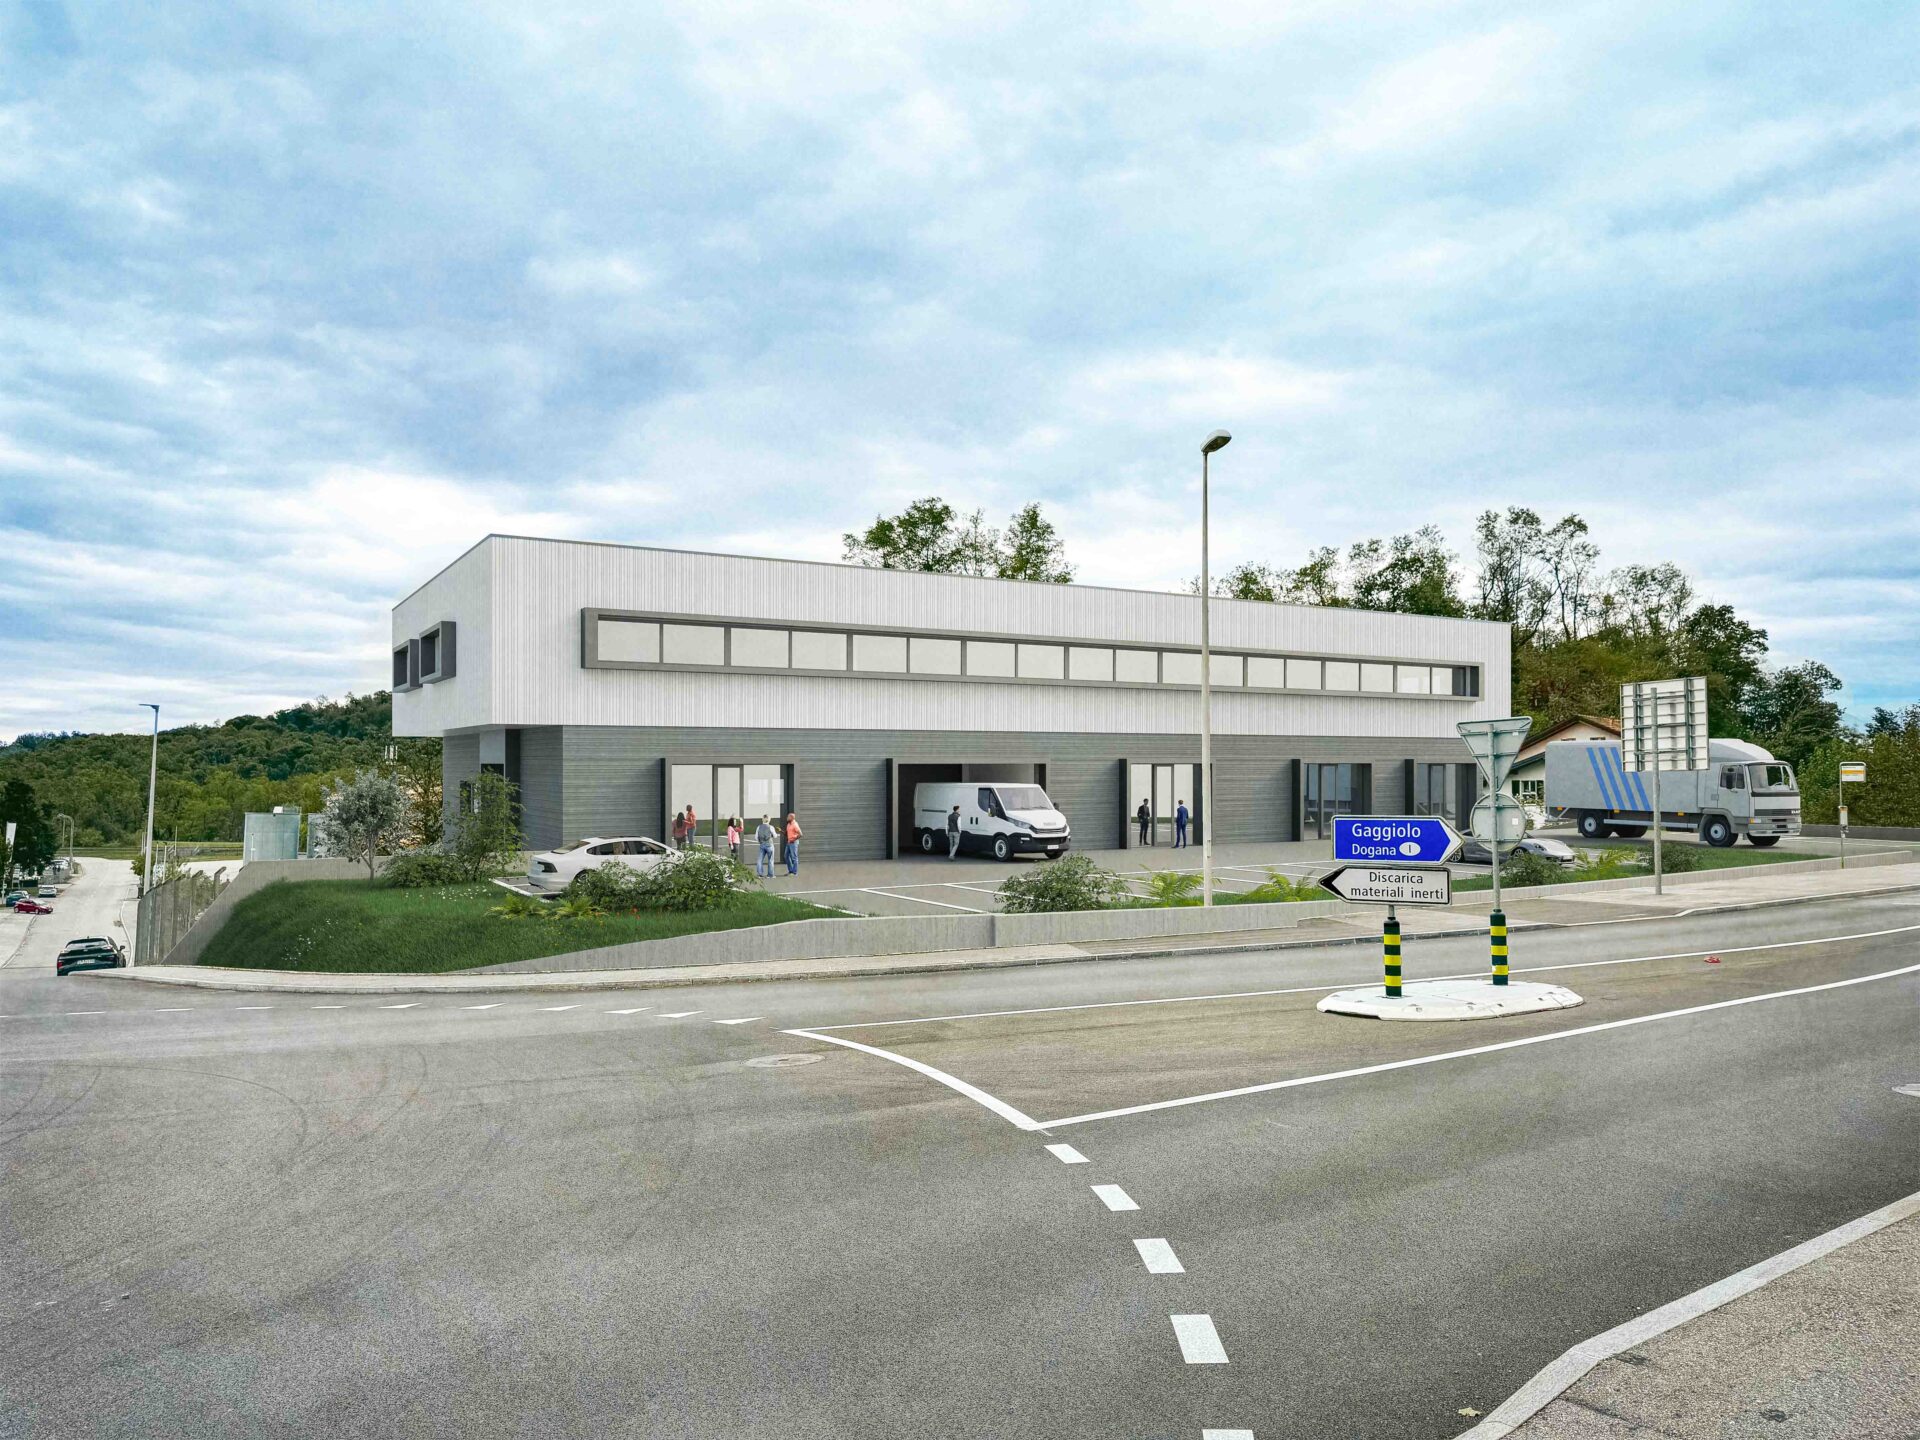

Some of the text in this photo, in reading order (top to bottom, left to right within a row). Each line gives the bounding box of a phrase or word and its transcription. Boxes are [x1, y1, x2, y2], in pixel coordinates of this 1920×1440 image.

[1351, 823, 1421, 841] Gaggiolo
[1352, 844, 1397, 858] Dogana
[1369, 871, 1424, 884] Discarica
[1350, 886, 1444, 899] materiali inerti
